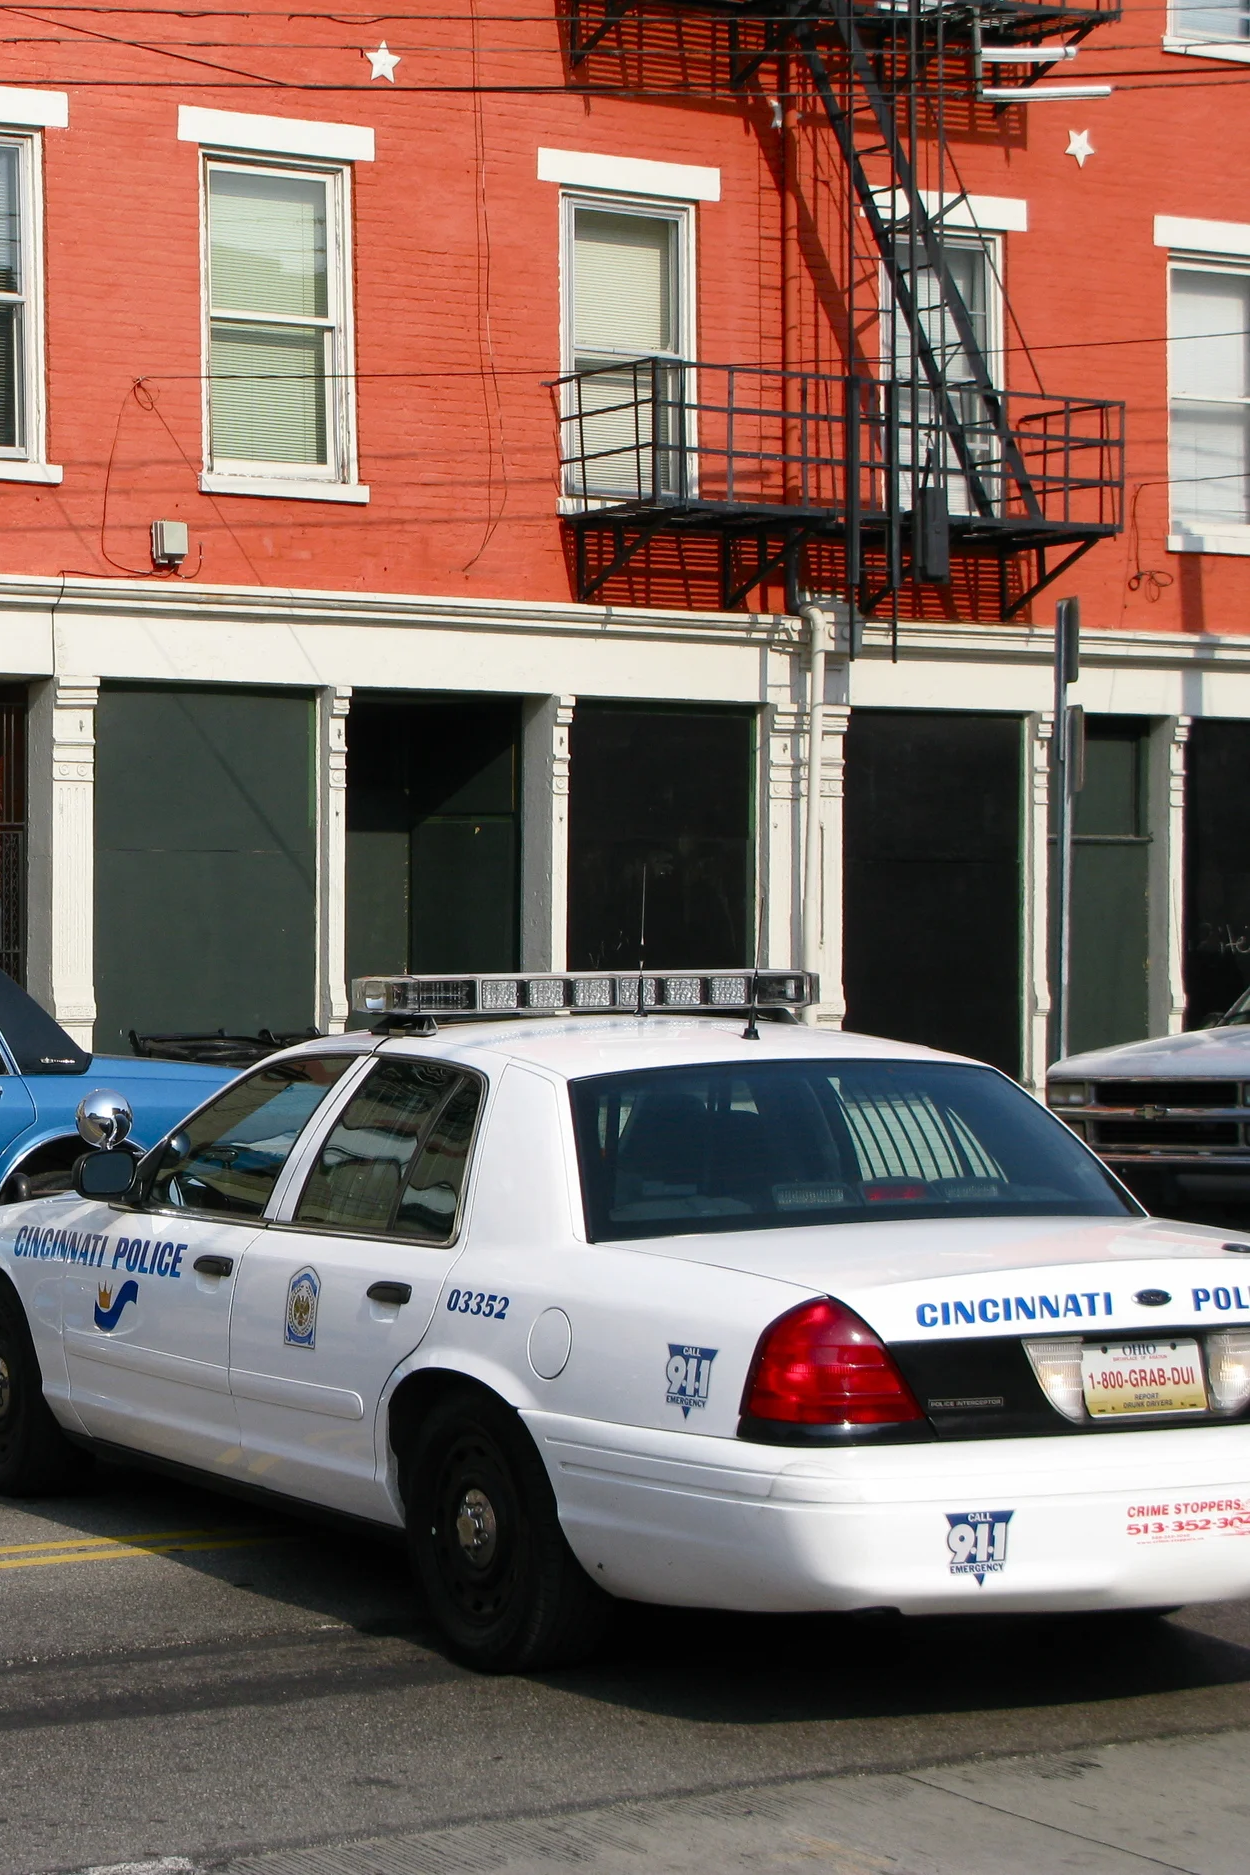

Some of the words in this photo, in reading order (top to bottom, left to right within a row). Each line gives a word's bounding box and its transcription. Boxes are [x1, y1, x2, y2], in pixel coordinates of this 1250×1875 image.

[13, 1225, 109, 1268] CINCINNATI
[111, 1237, 188, 1278] POLICE
[446, 1288, 510, 1320] 03352
[915, 1291, 1113, 1328] CINCINNATI
[682, 1346, 701, 1357] CALL
[1122, 1343, 1156, 1356] OHIO
[1088, 1366, 1196, 1390] 1-800-GRAB-DUI
[666, 1395, 707, 1408] EMERGENCY
[1134, 1392, 1159, 1400] REPORT
[1123, 1400, 1145, 1409] DRUNK
[1146, 1399, 1173, 1408] DRIVERS
[1127, 1504, 1170, 1518] CRIME
[1174, 1498, 1241, 1515] STOPPERS
[967, 1512, 992, 1522] CALL
[950, 1563, 1004, 1574] EMERGENCY
